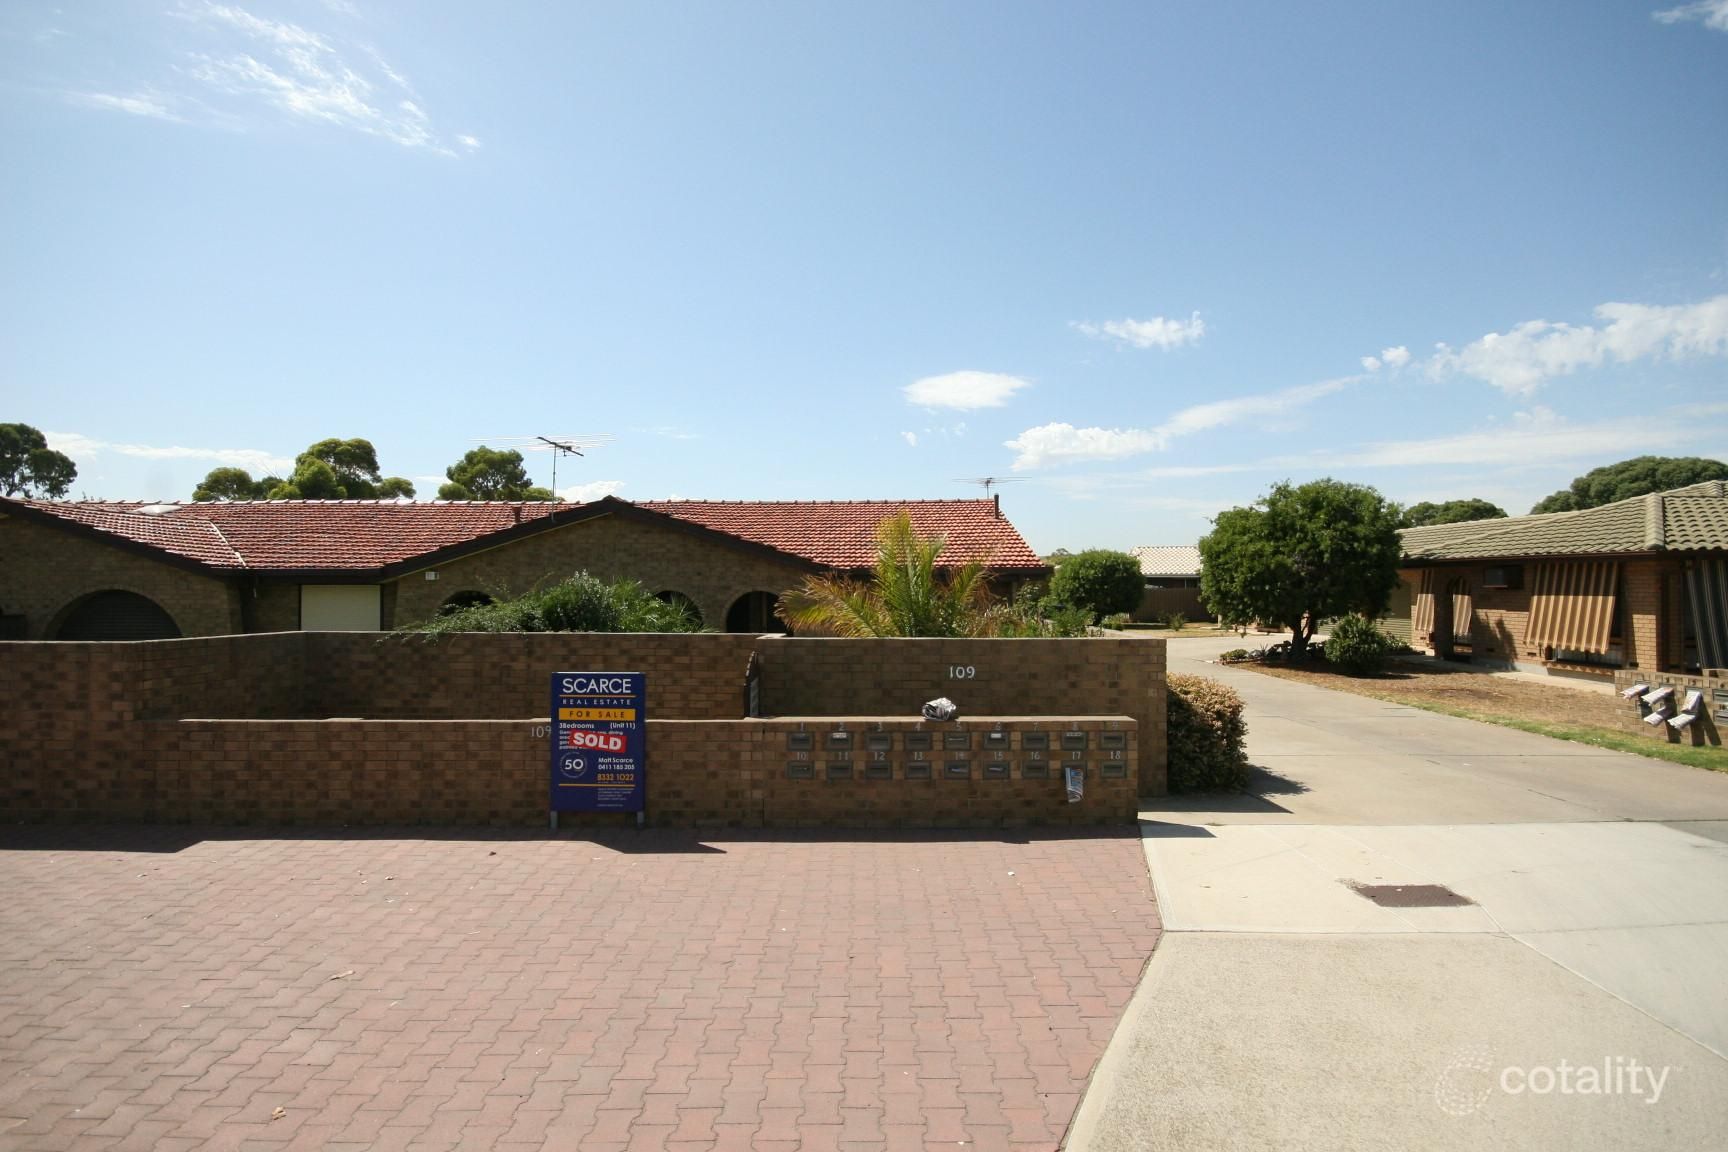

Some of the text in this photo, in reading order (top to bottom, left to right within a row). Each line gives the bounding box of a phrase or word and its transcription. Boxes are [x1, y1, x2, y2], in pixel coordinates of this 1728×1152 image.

[949, 665, 976, 679] 109
[562, 678, 632, 694] SCARCE
[914, 722, 921, 731] 4
[573, 732, 622, 751] SOLD
[796, 751, 807, 760] 10
[837, 751, 849, 760] 11
[873, 751, 885, 760] 12
[914, 751, 923, 760] 13
[993, 751, 1004, 760] 15
[1031, 751, 1041, 760] 16
[1071, 751, 1081, 760] 17
[1110, 751, 1121, 760] 18
[616, 773, 634, 781] 1022
